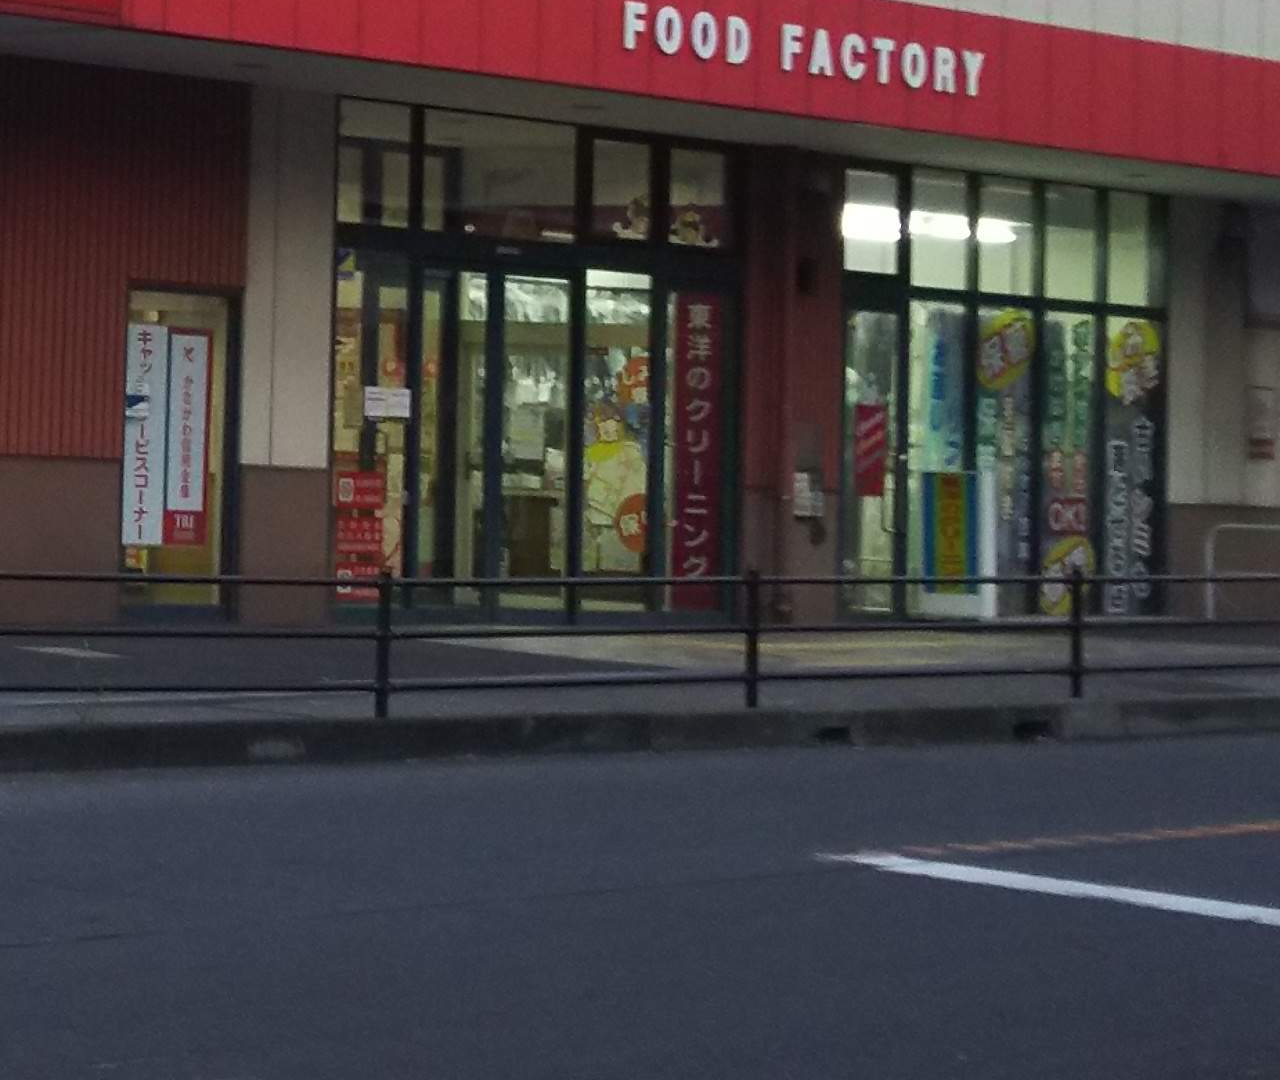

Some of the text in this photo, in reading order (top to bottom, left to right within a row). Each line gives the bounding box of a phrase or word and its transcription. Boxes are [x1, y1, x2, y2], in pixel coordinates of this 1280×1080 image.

[623, 0, 985, 97] FOOD FACTORY
[133, 329, 154, 540] キャッービスコーナー
